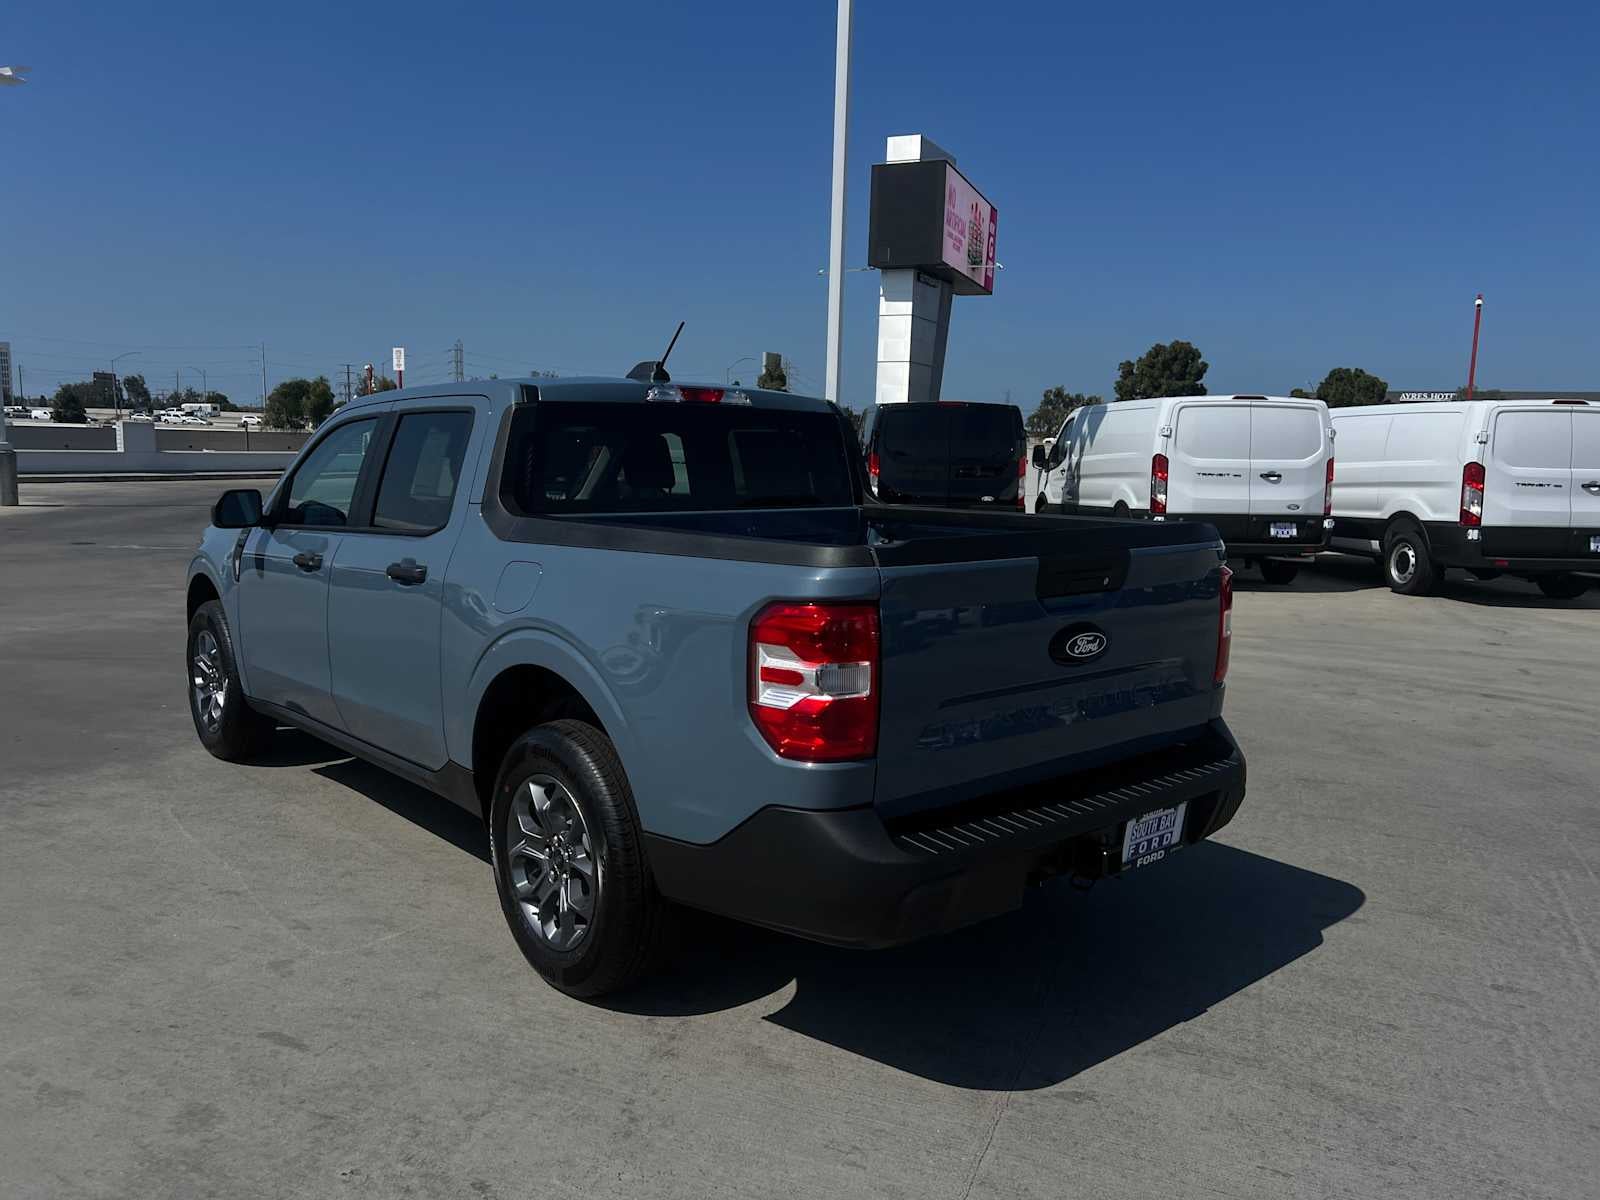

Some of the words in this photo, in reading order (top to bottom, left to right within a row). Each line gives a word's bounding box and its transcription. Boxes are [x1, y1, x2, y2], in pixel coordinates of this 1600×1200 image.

[1400, 392, 1428, 400] AYRES
[1074, 636, 1100, 654] Ford
[1131, 819, 1159, 841] SOUTH
[1160, 810, 1177, 831] BAY
[1128, 833, 1172, 858] FORD
[1137, 850, 1165, 868] FORD
